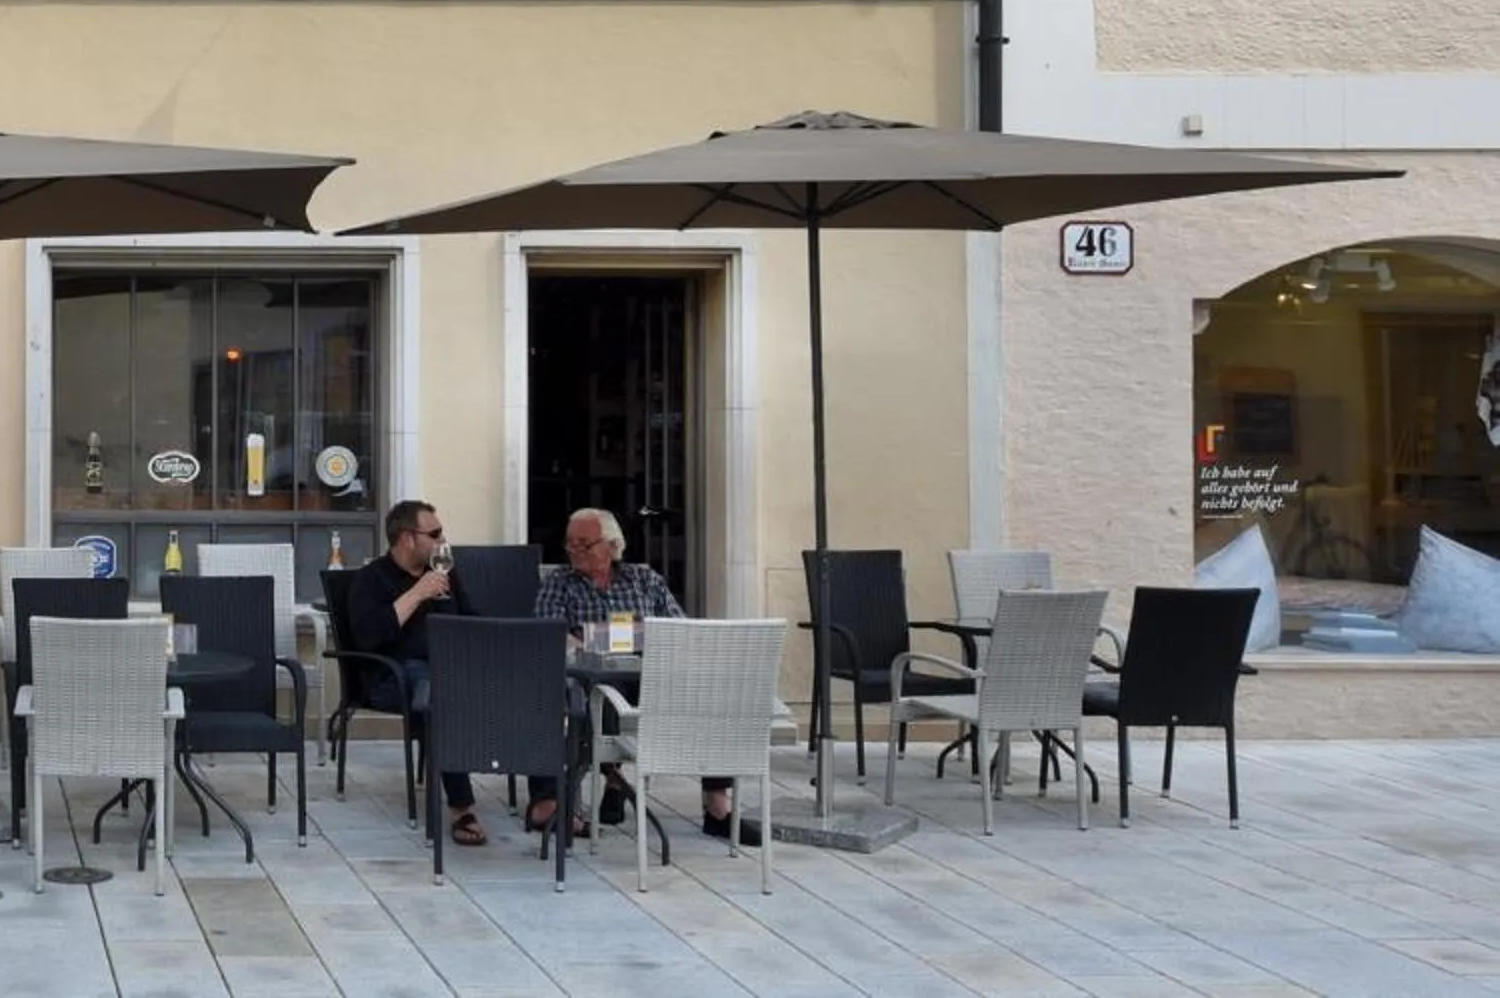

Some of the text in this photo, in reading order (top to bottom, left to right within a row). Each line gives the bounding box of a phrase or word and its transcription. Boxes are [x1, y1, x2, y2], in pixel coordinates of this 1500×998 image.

[1075, 225, 1118, 257] 46
[1200, 464, 1279, 481] Ich habe auf
[1200, 479, 1299, 497] alles gehört und
[1201, 496, 1238, 509] nichts
